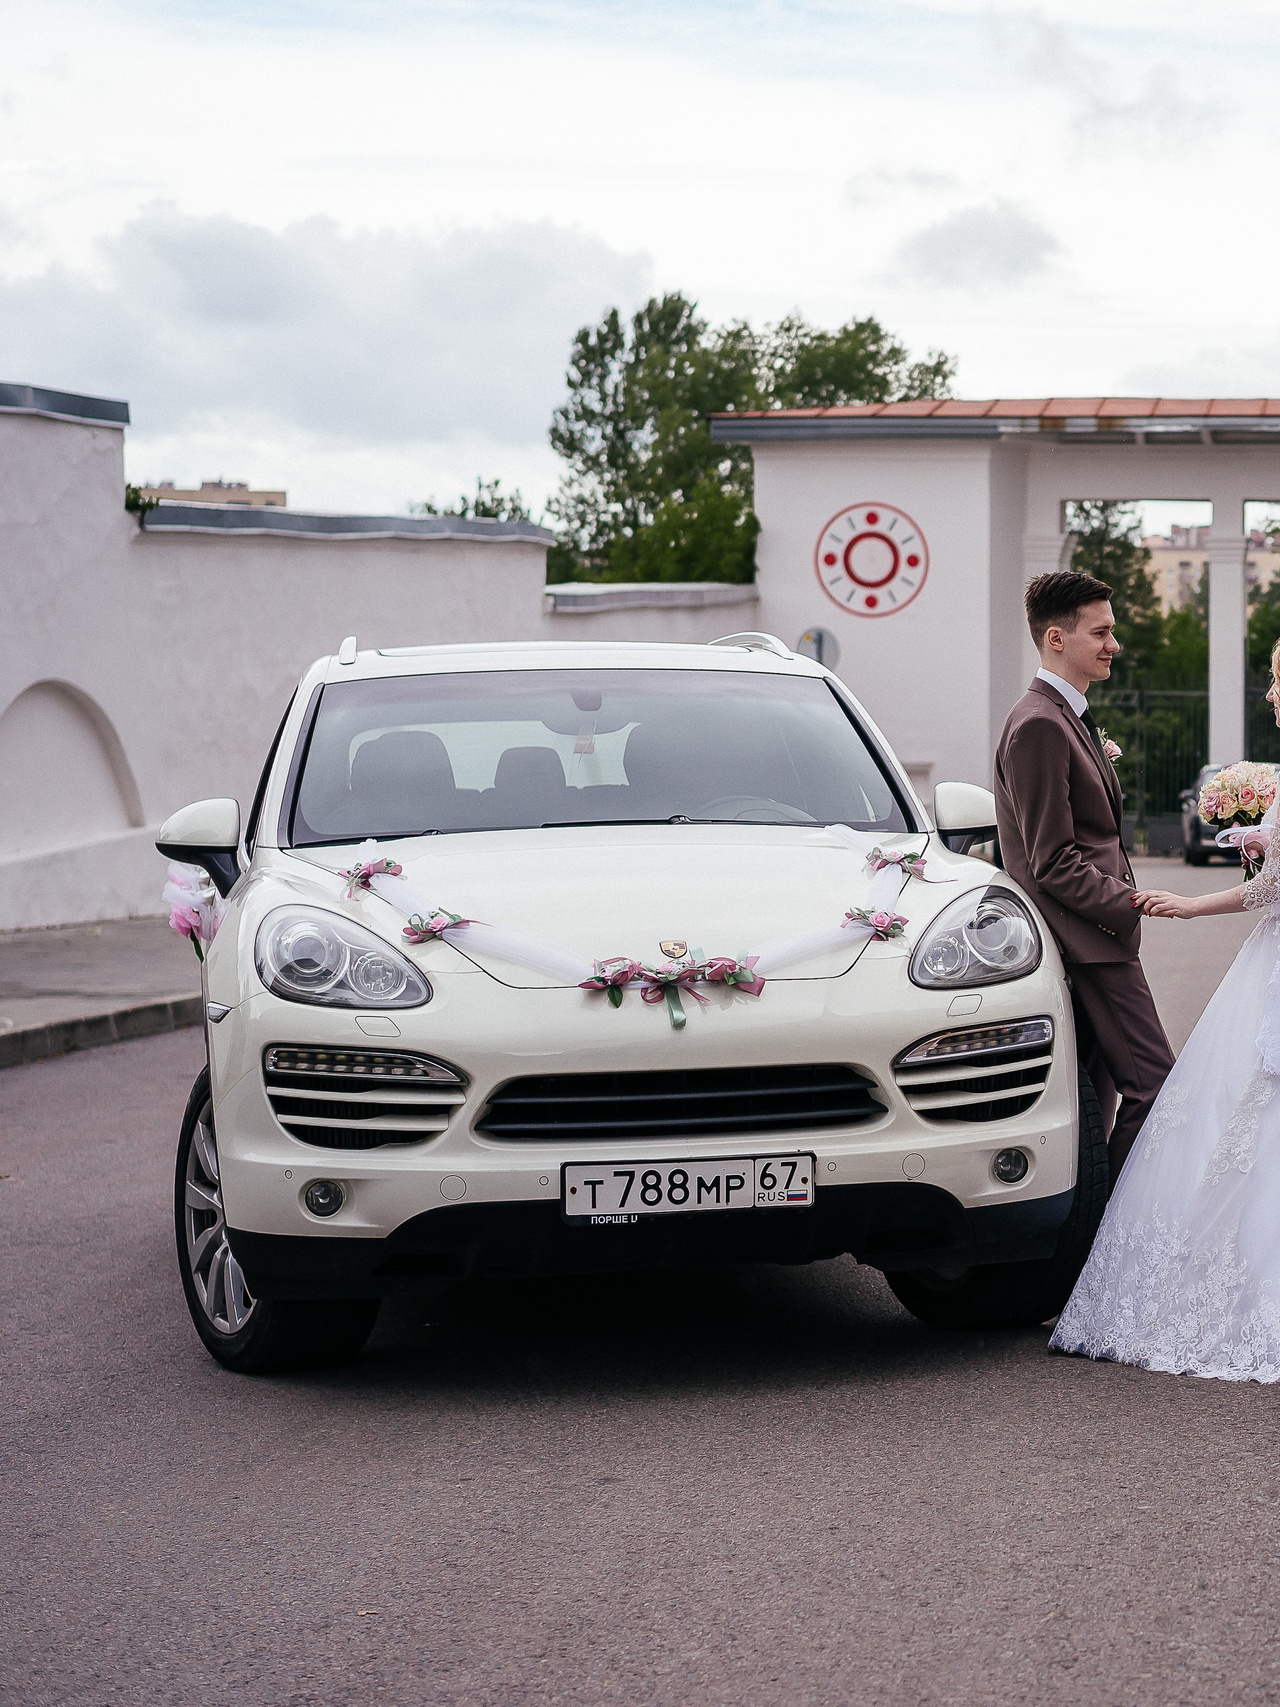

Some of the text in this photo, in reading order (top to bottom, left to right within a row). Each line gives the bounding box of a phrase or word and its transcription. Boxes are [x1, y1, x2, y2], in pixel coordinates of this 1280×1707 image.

[759, 1161, 798, 1190] 67
[757, 1191, 786, 1202] RUS
[591, 1215, 629, 1224] ПОРШЕ
